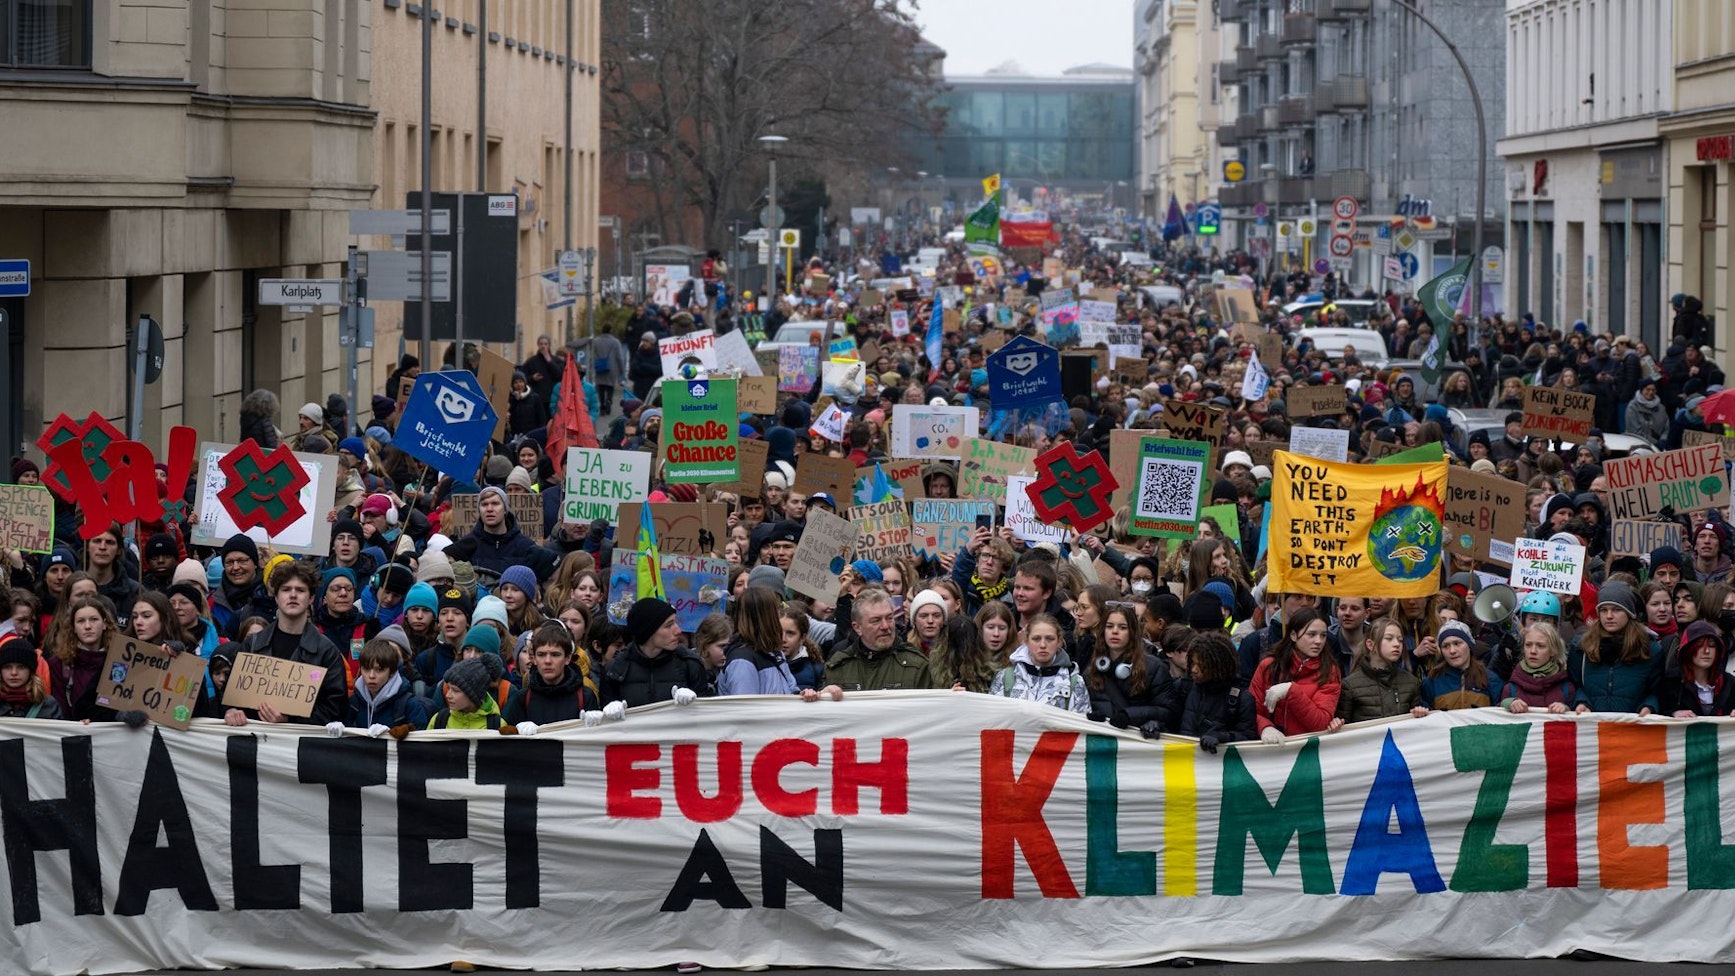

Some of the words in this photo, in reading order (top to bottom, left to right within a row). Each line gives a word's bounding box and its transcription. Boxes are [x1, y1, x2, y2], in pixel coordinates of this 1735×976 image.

[490, 201, 505, 209] ABG
[1339, 203, 1353, 214] 30
[1396, 194, 1430, 215] dm
[281, 285, 322, 299] Karlplatz
[661, 335, 714, 355] ZUKUNFT
[577, 351, 584, 361] P
[1002, 377, 1047, 391] Briefwahl
[681, 404, 702, 412] kleiner
[1551, 406, 1567, 415] AUF
[1564, 394, 1590, 411] BOCK
[415, 421, 466, 457] Briefwahl
[673, 420, 728, 442] Große
[667, 443, 736, 463] Chance
[1144, 443, 1185, 456] Briefwahl
[1186, 448, 1205, 457] hier:
[577, 451, 603, 474] JA
[1286, 463, 1328, 480] YOU
[1607, 445, 1724, 489] KLIMASCHUTZ
[568, 477, 642, 500] LEBENS-
[1291, 481, 1347, 501] NEED
[1481, 487, 1491, 502] is
[1496, 494, 1511, 506] no
[1612, 487, 1657, 519] WEIL
[1660, 479, 1700, 510] BAUM
[851, 504, 877, 519] IT'S
[878, 500, 903, 516] OUR
[913, 501, 947, 523] GANZ
[1314, 505, 1357, 522] THIS
[1007, 513, 1023, 527] NO
[1134, 519, 1194, 535] berlin2030.org
[1290, 519, 1350, 536] EARTH,
[857, 534, 875, 549] SO
[878, 528, 908, 547] STOP
[938, 525, 970, 550] EIS
[1291, 537, 1303, 548] SO
[1313, 538, 1347, 551] DON'T
[1523, 539, 1545, 549] Steckt
[1613, 521, 1634, 553] GO
[1637, 523, 1682, 555] VEGAN
[903, 543, 912, 556] IT
[1518, 548, 1548, 560] KOHLE
[620, 553, 637, 566] KE
[659, 556, 707, 575] LASTIK
[1291, 552, 1362, 570] DESTROY
[1530, 560, 1577, 575] ZUKUNFT
[1312, 573, 1336, 585] IT
[1521, 568, 1539, 576] nicht
[1522, 576, 1571, 591] KRAFTWERK
[122, 642, 171, 671] Spread
[241, 654, 279, 677] THERE
[288, 665, 305, 682] IS
[112, 684, 134, 700] not
[163, 673, 198, 700] LOVE
[236, 675, 253, 691] NO
[256, 677, 305, 701] PLANET
[305, 685, 317, 703] B
[605, 738, 909, 823] EUCH
[980, 721, 1735, 900] KLIMAZIEL
[0, 726, 565, 925] HALTET
[660, 824, 844, 913] AN
